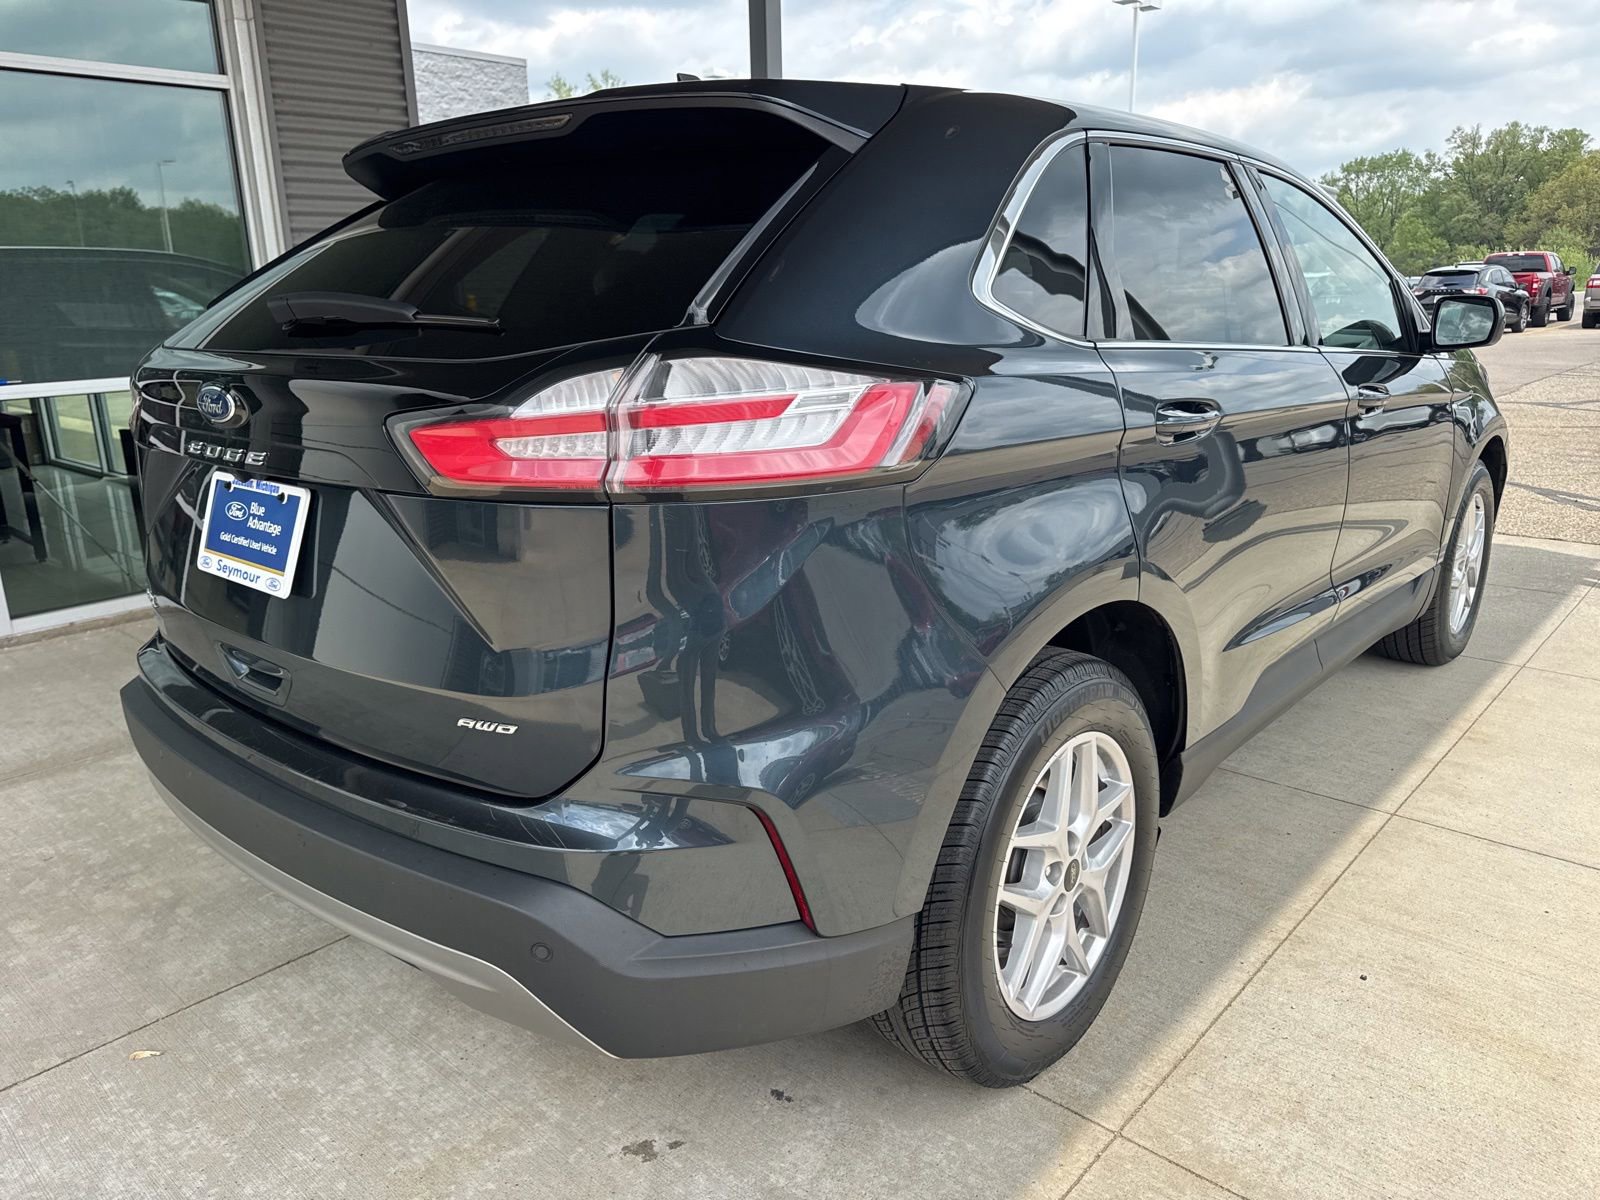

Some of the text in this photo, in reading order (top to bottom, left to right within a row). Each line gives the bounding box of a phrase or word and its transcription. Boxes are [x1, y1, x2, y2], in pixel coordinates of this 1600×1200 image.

[188, 441, 267, 465] EDGE
[256, 480, 279, 496] Michigan
[250, 502, 266, 517] Blue
[247, 516, 282, 537] Advantage
[220, 532, 277, 555] Gold Certified Used Vehicle
[216, 559, 261, 583] Seymour
[456, 717, 519, 735] AWD
